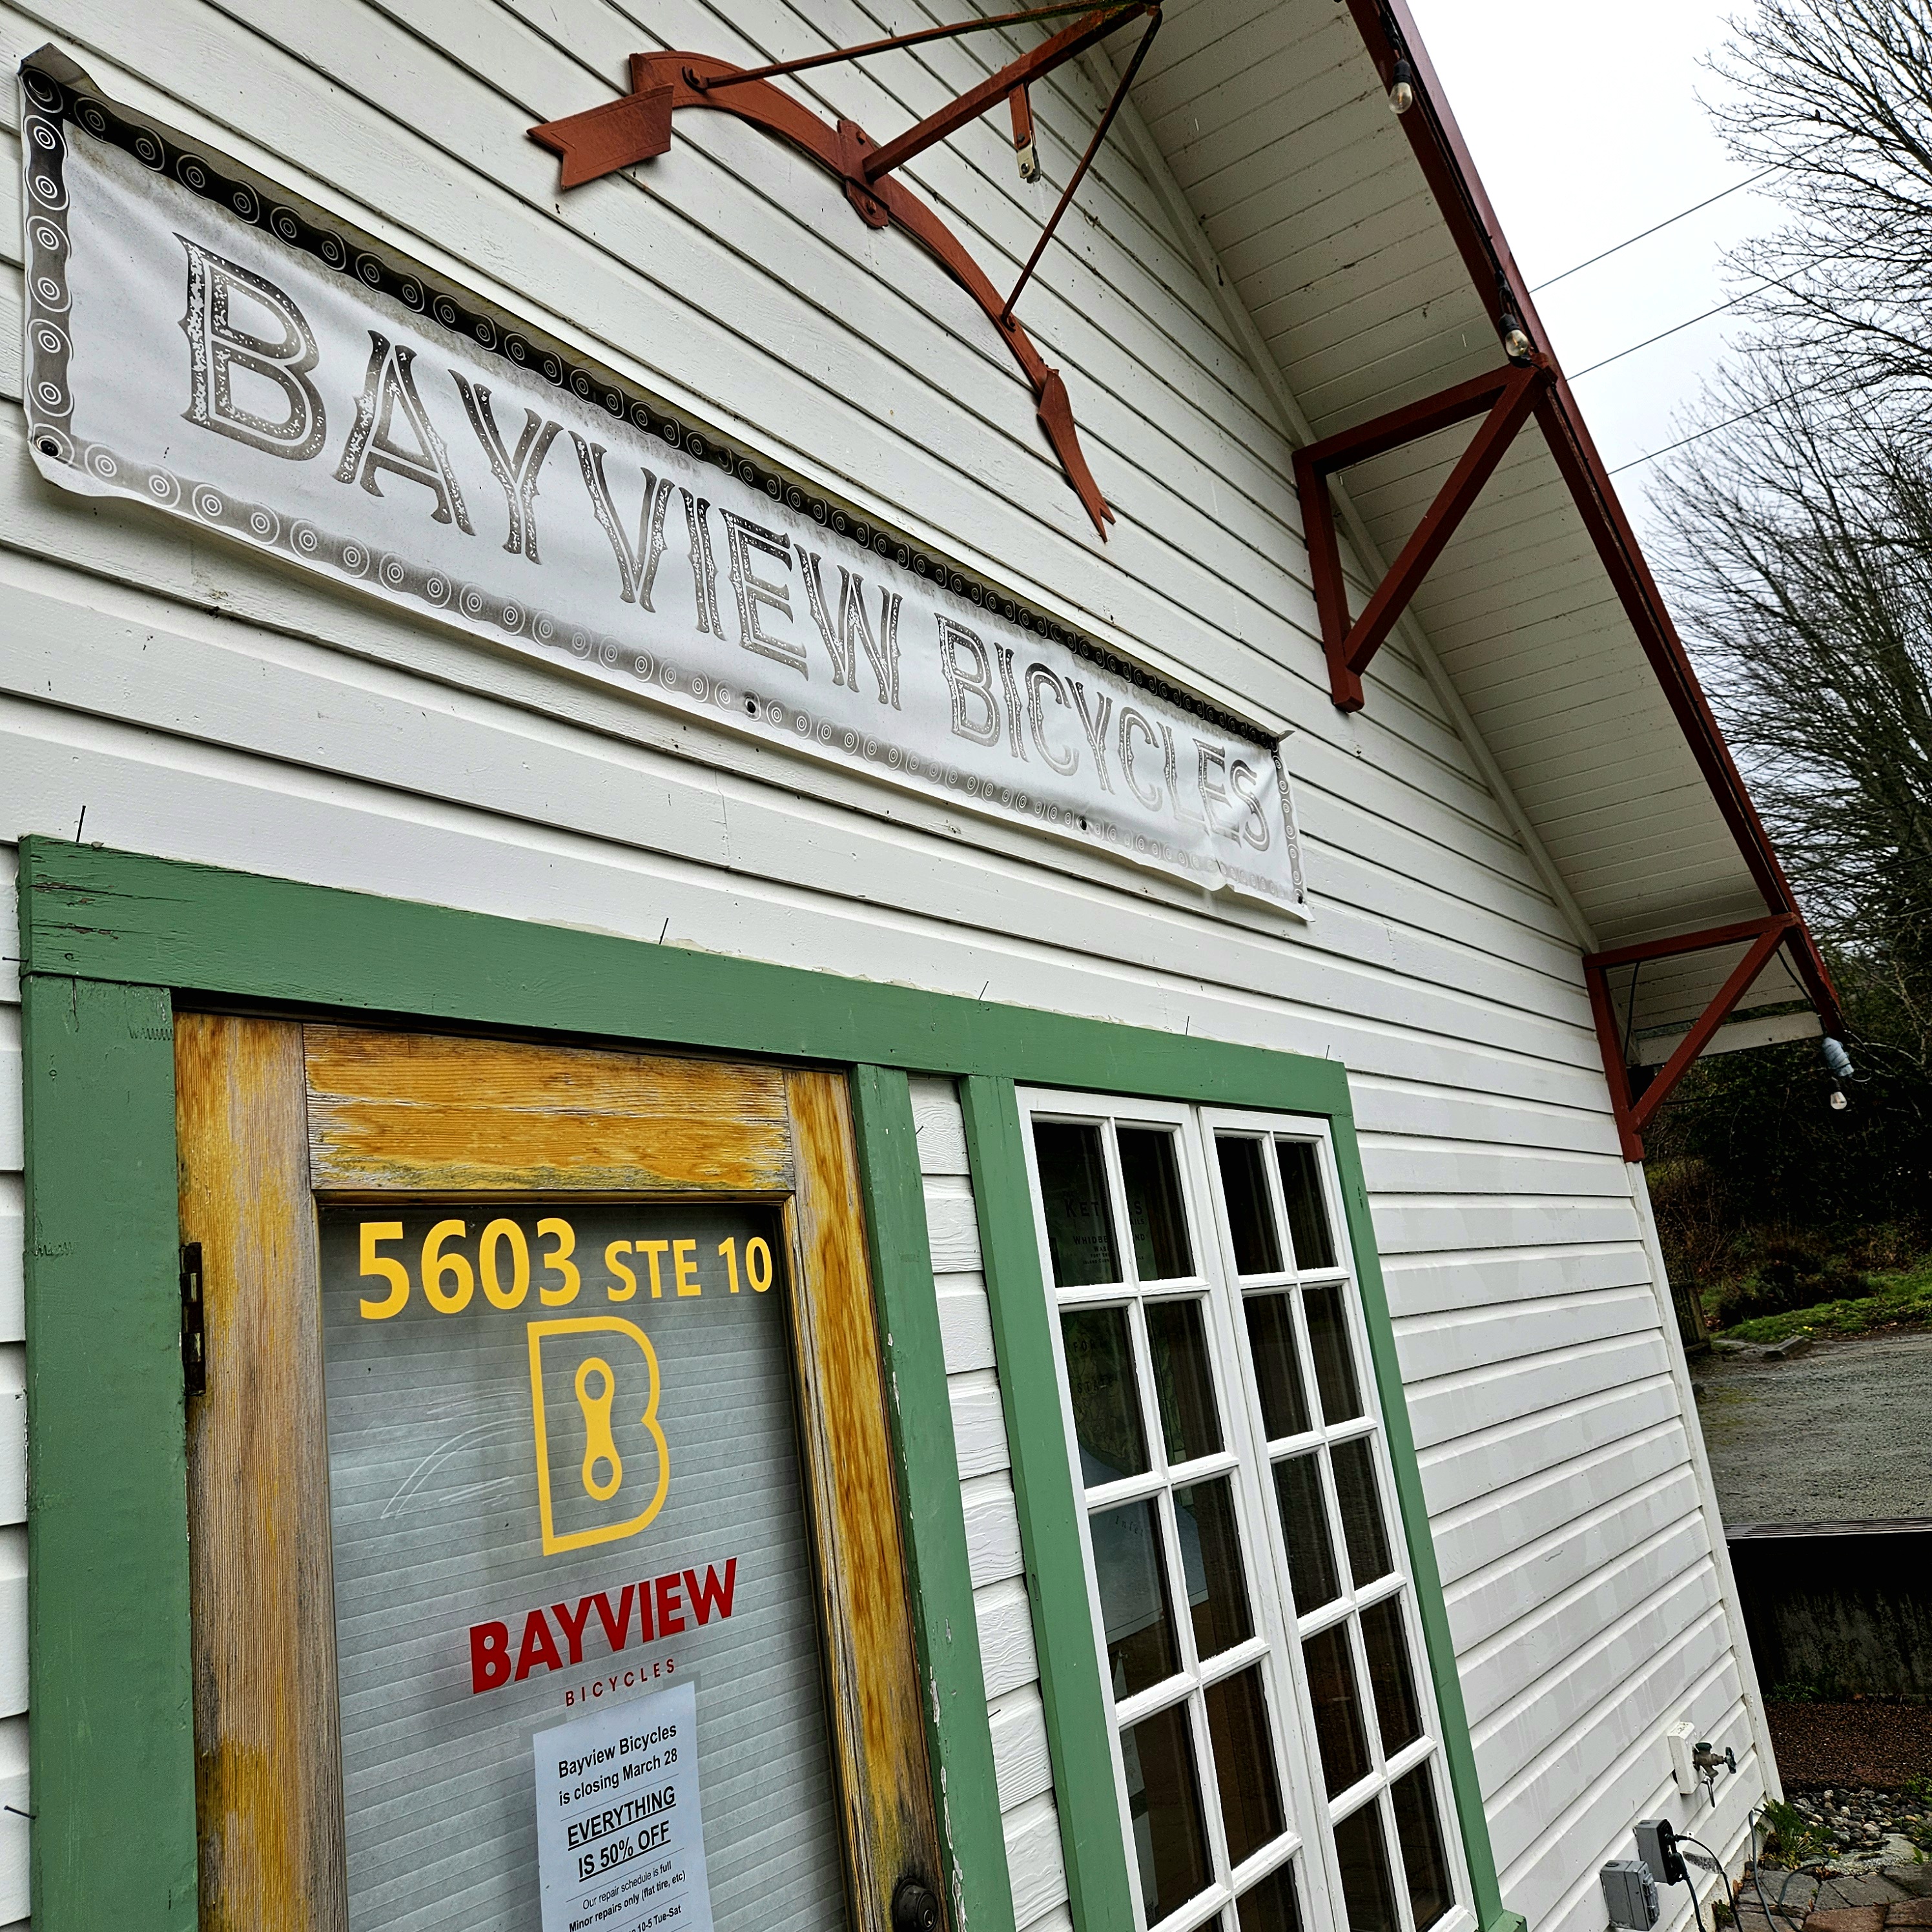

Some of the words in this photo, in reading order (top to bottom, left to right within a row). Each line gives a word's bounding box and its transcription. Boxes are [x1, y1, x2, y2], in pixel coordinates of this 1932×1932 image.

[172, 232, 902, 711] BAYVIEW
[934, 613, 1270, 852] BICYCLES
[360, 1218, 580, 1319] 5603
[605, 1240, 701, 1301] STE
[719, 1237, 772, 1293] 10
[1073, 1235, 1108, 1245] WHIDBE
[470, 1557, 737, 1694] BAYVIEW
[566, 1658, 674, 1707] BICYCLES
[559, 1745, 616, 1778] Bayview
[619, 1725, 677, 1756] Bicycles
[559, 1791, 571, 1807] is
[574, 1773, 619, 1802] closing
[623, 1754, 661, 1781] March
[664, 1748, 678, 1766] 28
[568, 1786, 676, 1849] EVERYTHING
[579, 1853, 595, 1879] IS
[601, 1836, 633, 1868] 50%
[638, 1820, 670, 1851] OFF
[569, 1915, 593, 1932] Minor
[595, 1902, 622, 1922] repairs
[624, 1893, 639, 1907] only
[641, 1885, 655, 1902] (flat
[657, 1878, 670, 1891] tire,
[672, 1870, 686, 1885] etc)
[582, 1898, 597, 1910] Our
[599, 1886, 619, 1904] repair
[621, 1872, 652, 1893] schedule
[653, 1868, 659, 1877] is
[659, 1860, 672, 1873] full
[637, 1918, 653, 1932] 10-5
[653, 1904, 682, 1926] Tue-Sat
